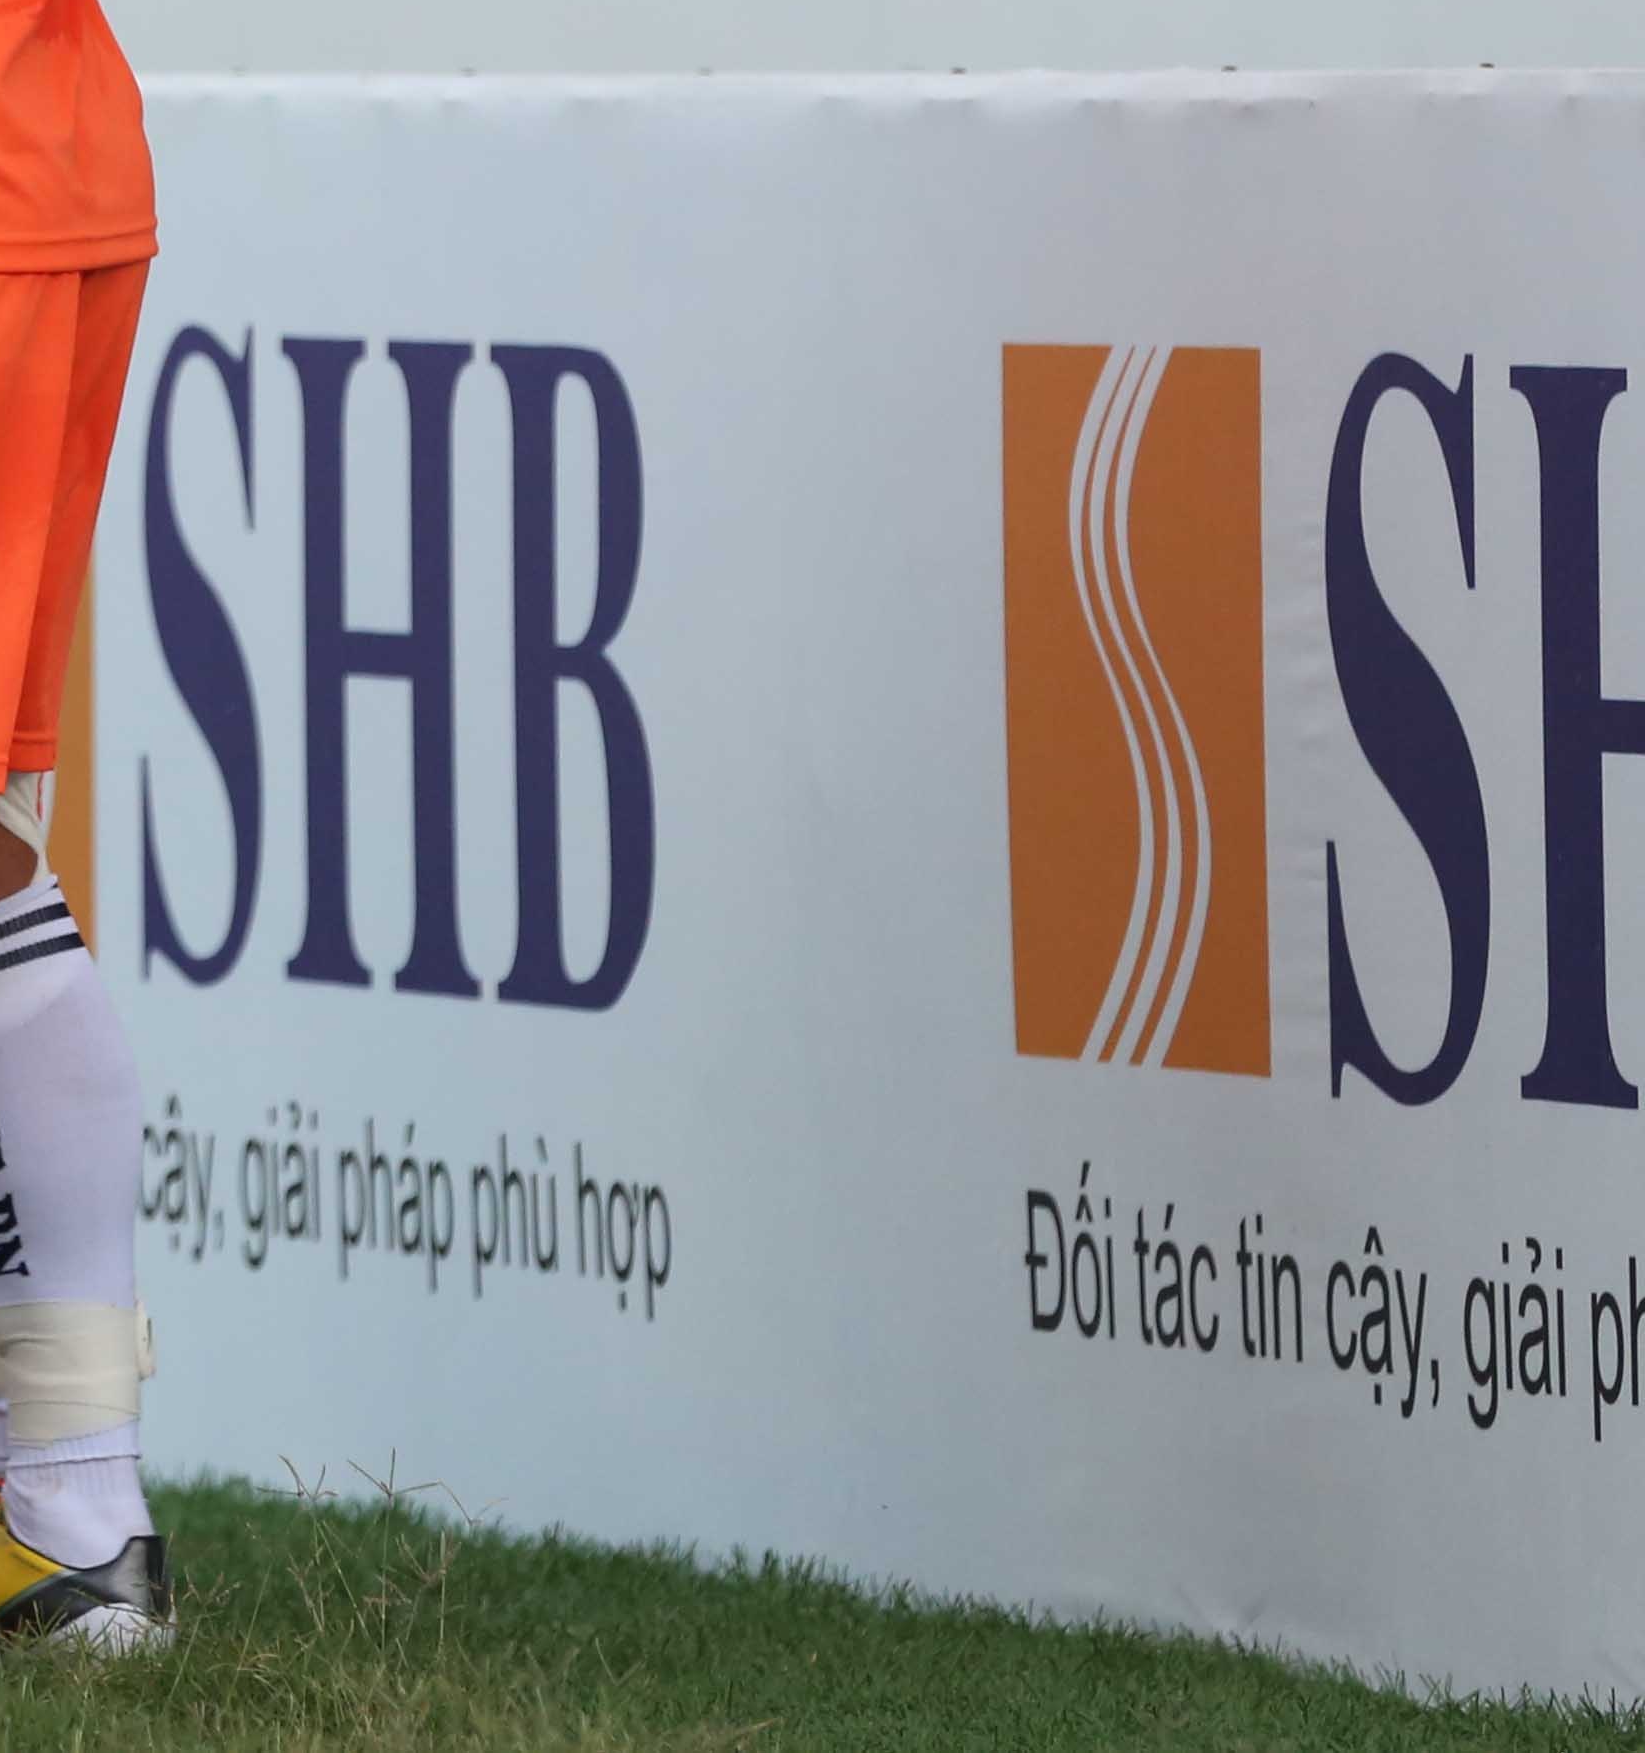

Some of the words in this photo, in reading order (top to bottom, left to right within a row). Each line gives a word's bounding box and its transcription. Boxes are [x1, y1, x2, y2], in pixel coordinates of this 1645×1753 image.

[139, 321, 657, 1014] SHB
[238, 1099, 320, 1271] giải
[336, 1115, 455, 1294] pháp
[472, 1131, 560, 1299] phù
[574, 1141, 672, 1323] hợp
[1025, 1160, 1115, 1340] Đối
[1133, 1203, 1220, 1352] tác
[1237, 1213, 1304, 1364] tin
[1326, 1226, 1440, 1419] cậy,
[1463, 1236, 1567, 1430] giải
